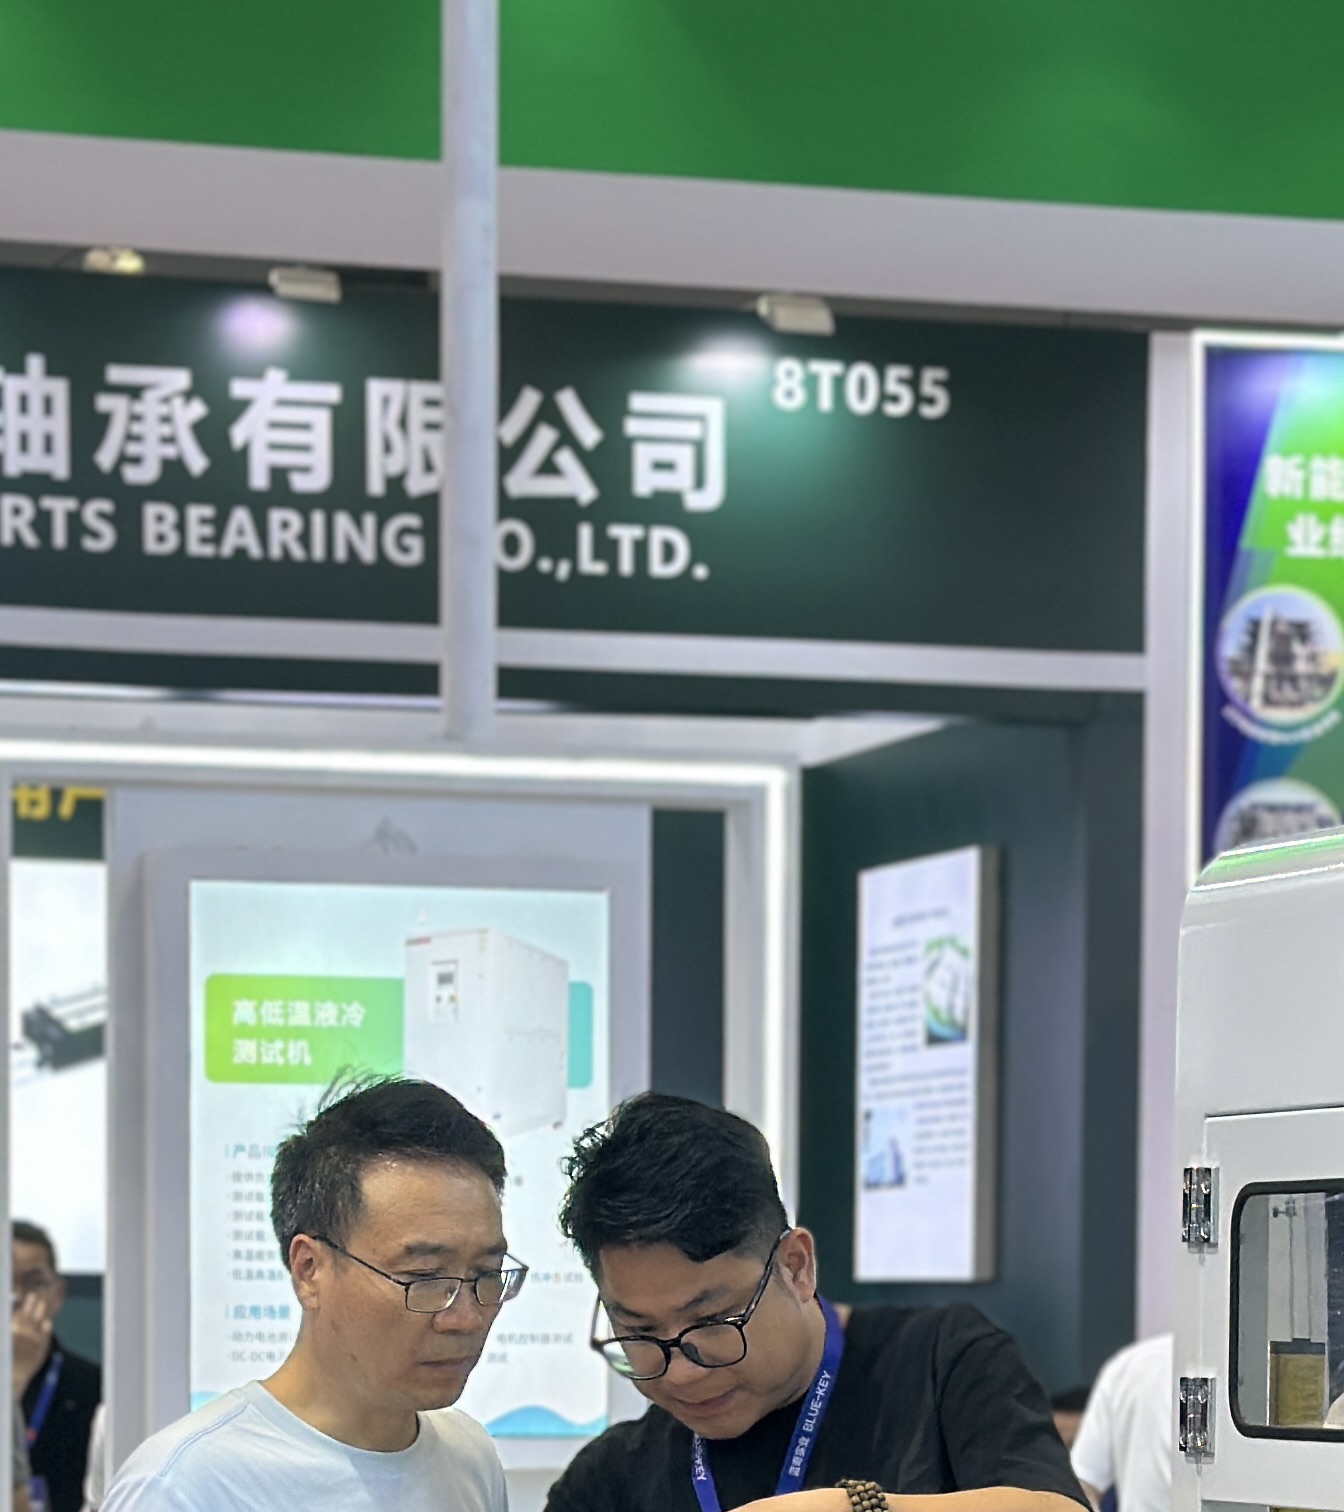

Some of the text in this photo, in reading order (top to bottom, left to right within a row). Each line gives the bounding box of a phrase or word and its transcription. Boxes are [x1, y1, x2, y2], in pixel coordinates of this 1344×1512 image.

[773, 357, 950, 418] 8T055
[142, 503, 425, 567] BEARING
[232, 998, 367, 1029] 高低温液冷
[232, 1038, 312, 1065] 测试机
[802, 1370, 831, 1432] BLUE-KEY
